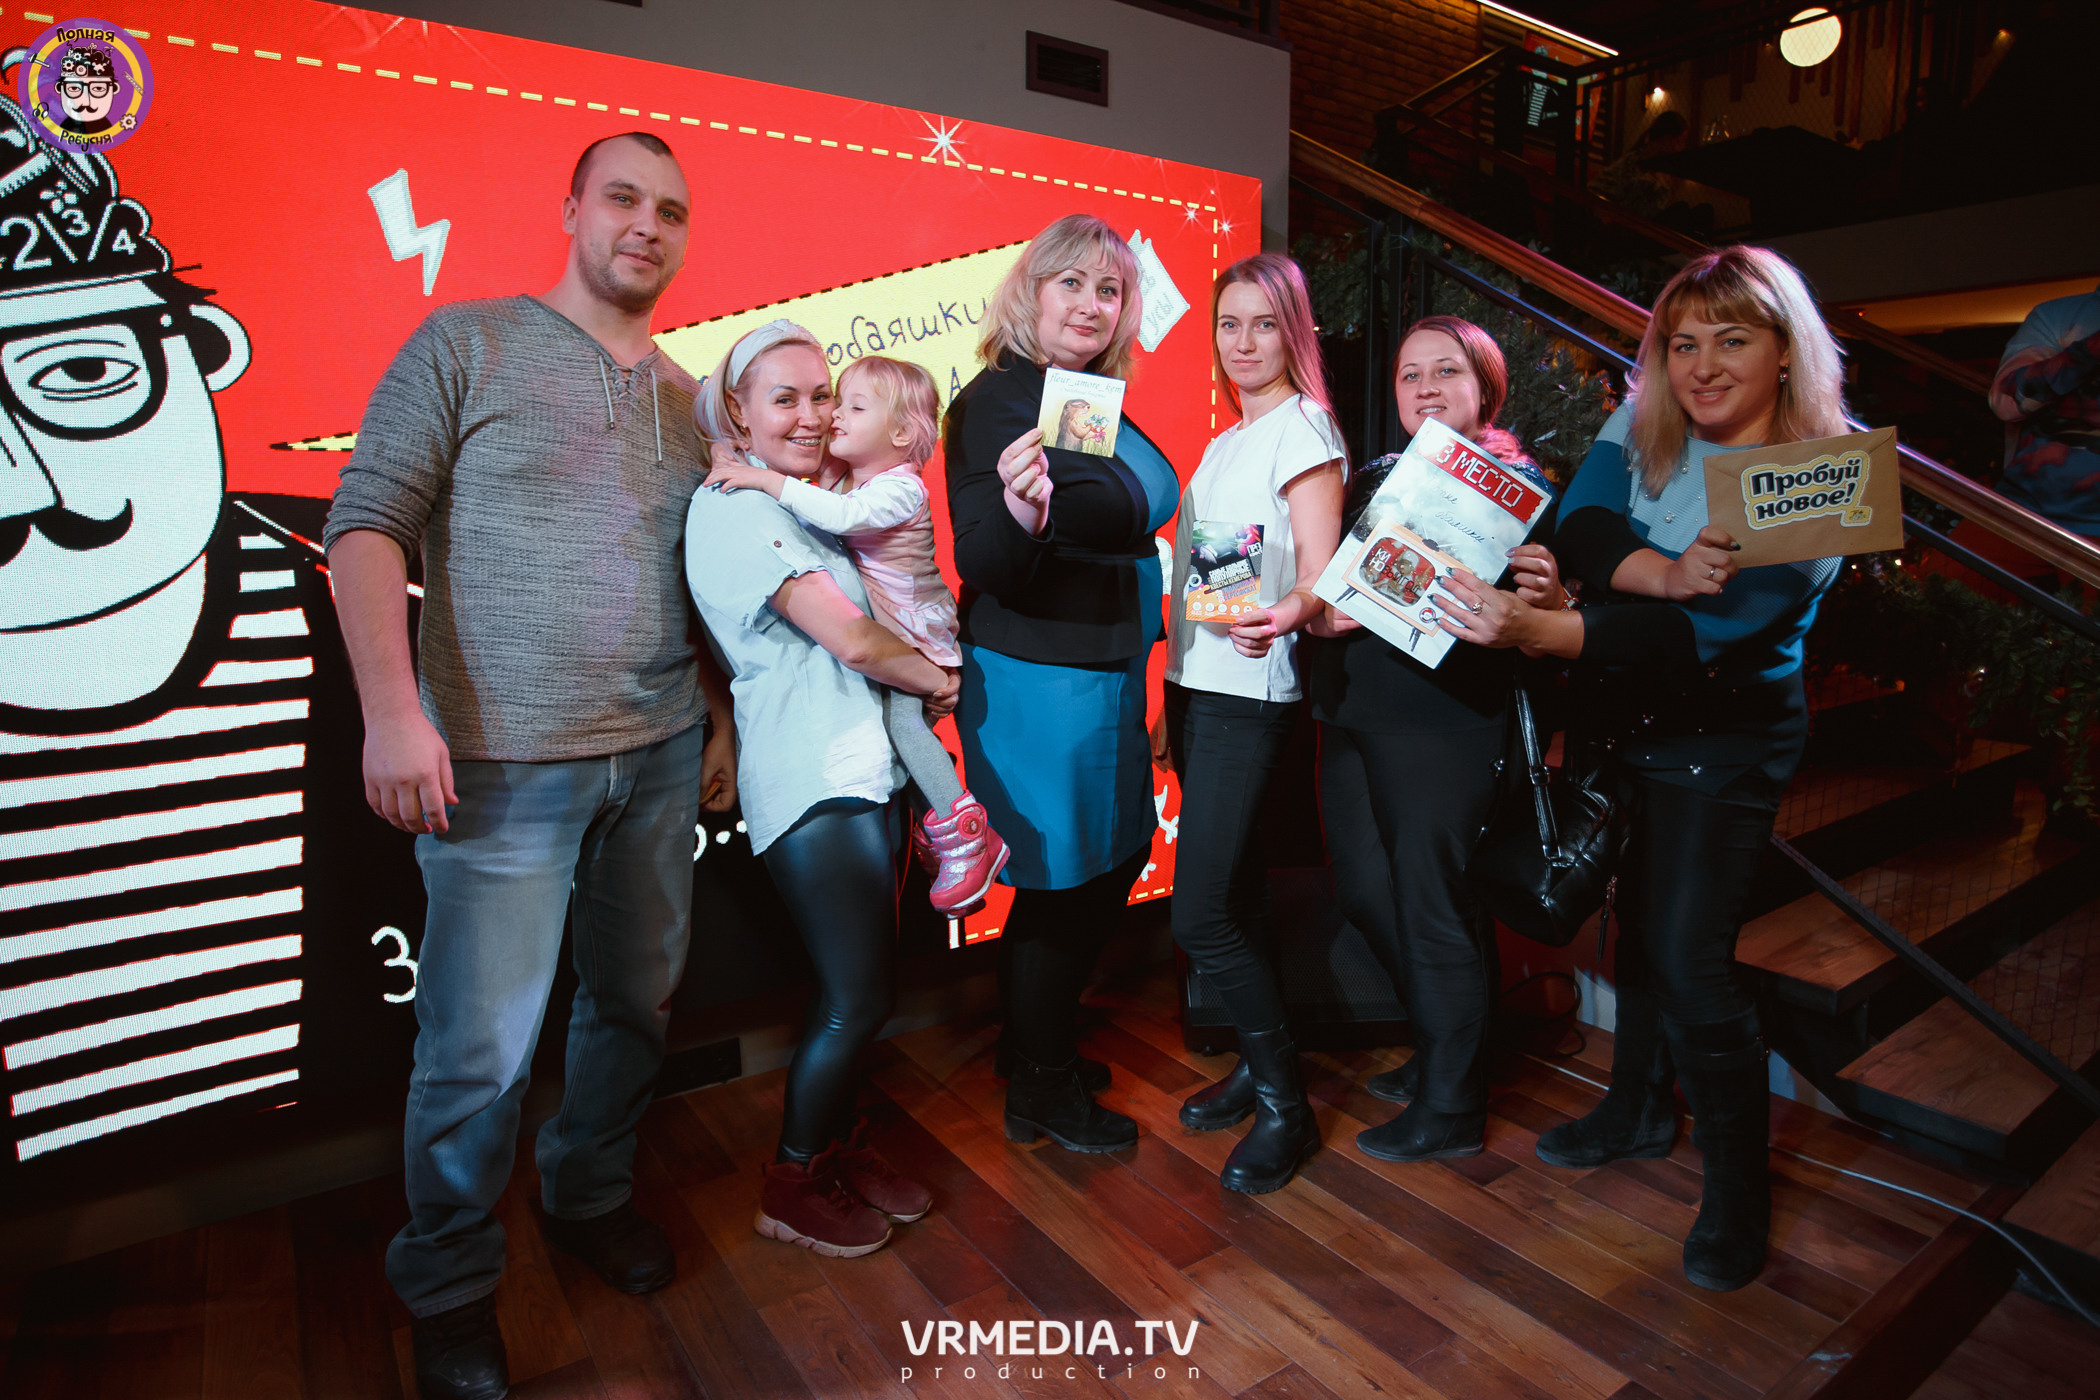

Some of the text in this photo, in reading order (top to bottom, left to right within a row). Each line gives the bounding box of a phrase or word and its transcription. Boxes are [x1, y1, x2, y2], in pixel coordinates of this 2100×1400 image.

[61, 208, 91, 237] 3
[112, 228, 137, 255] 4
[1435, 442, 1456, 464] 3
[1451, 450, 1525, 508] МЕСТО
[1751, 458, 1861, 497] Пробуй
[1755, 483, 1856, 520] новое!
